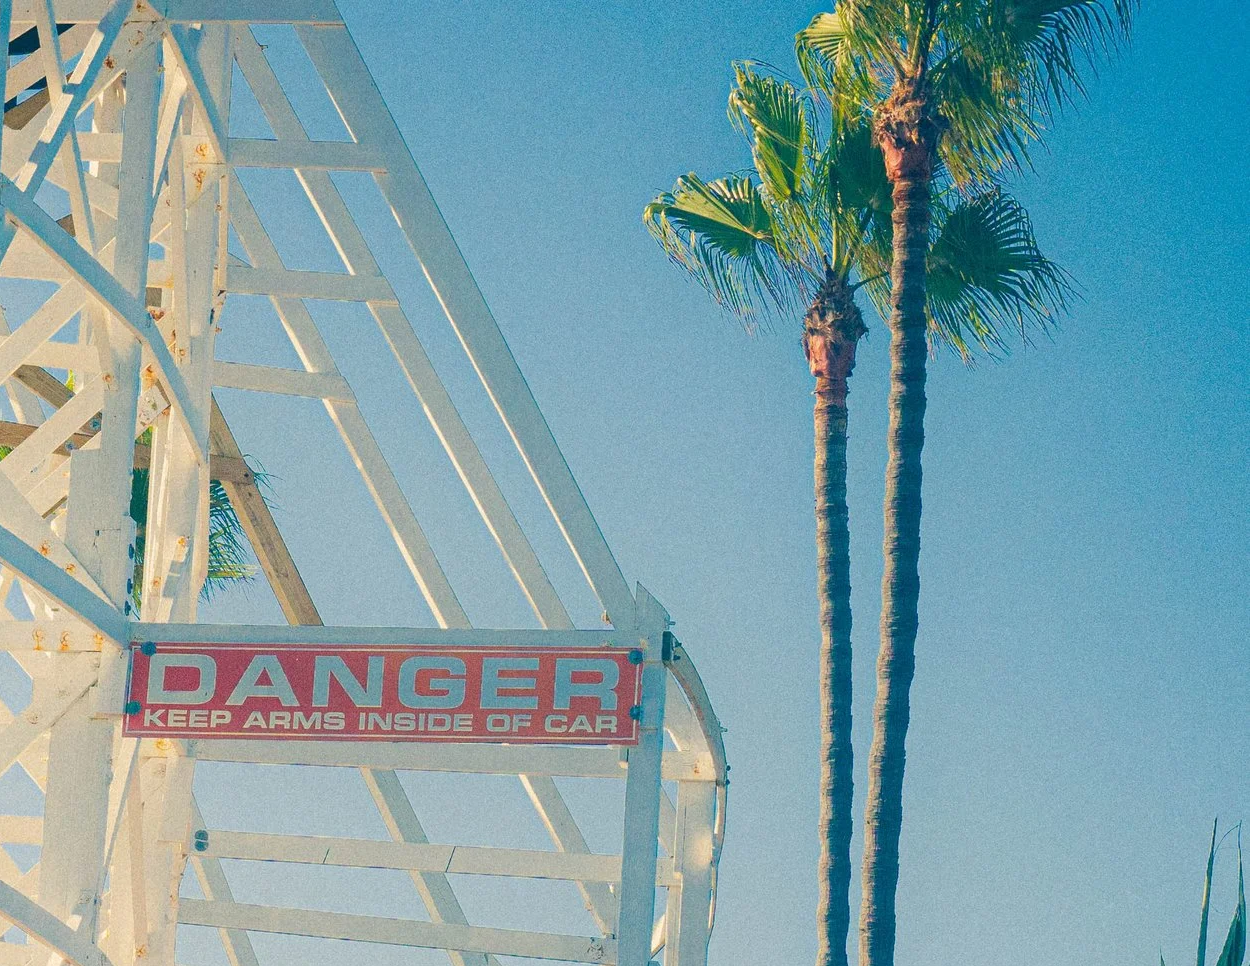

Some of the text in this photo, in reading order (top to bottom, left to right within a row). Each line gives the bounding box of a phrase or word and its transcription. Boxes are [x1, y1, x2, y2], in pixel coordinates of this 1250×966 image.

[146, 653, 620, 710] DANGER
[143, 708, 619, 734] KEEP ARMS INSIDE OF CAR
